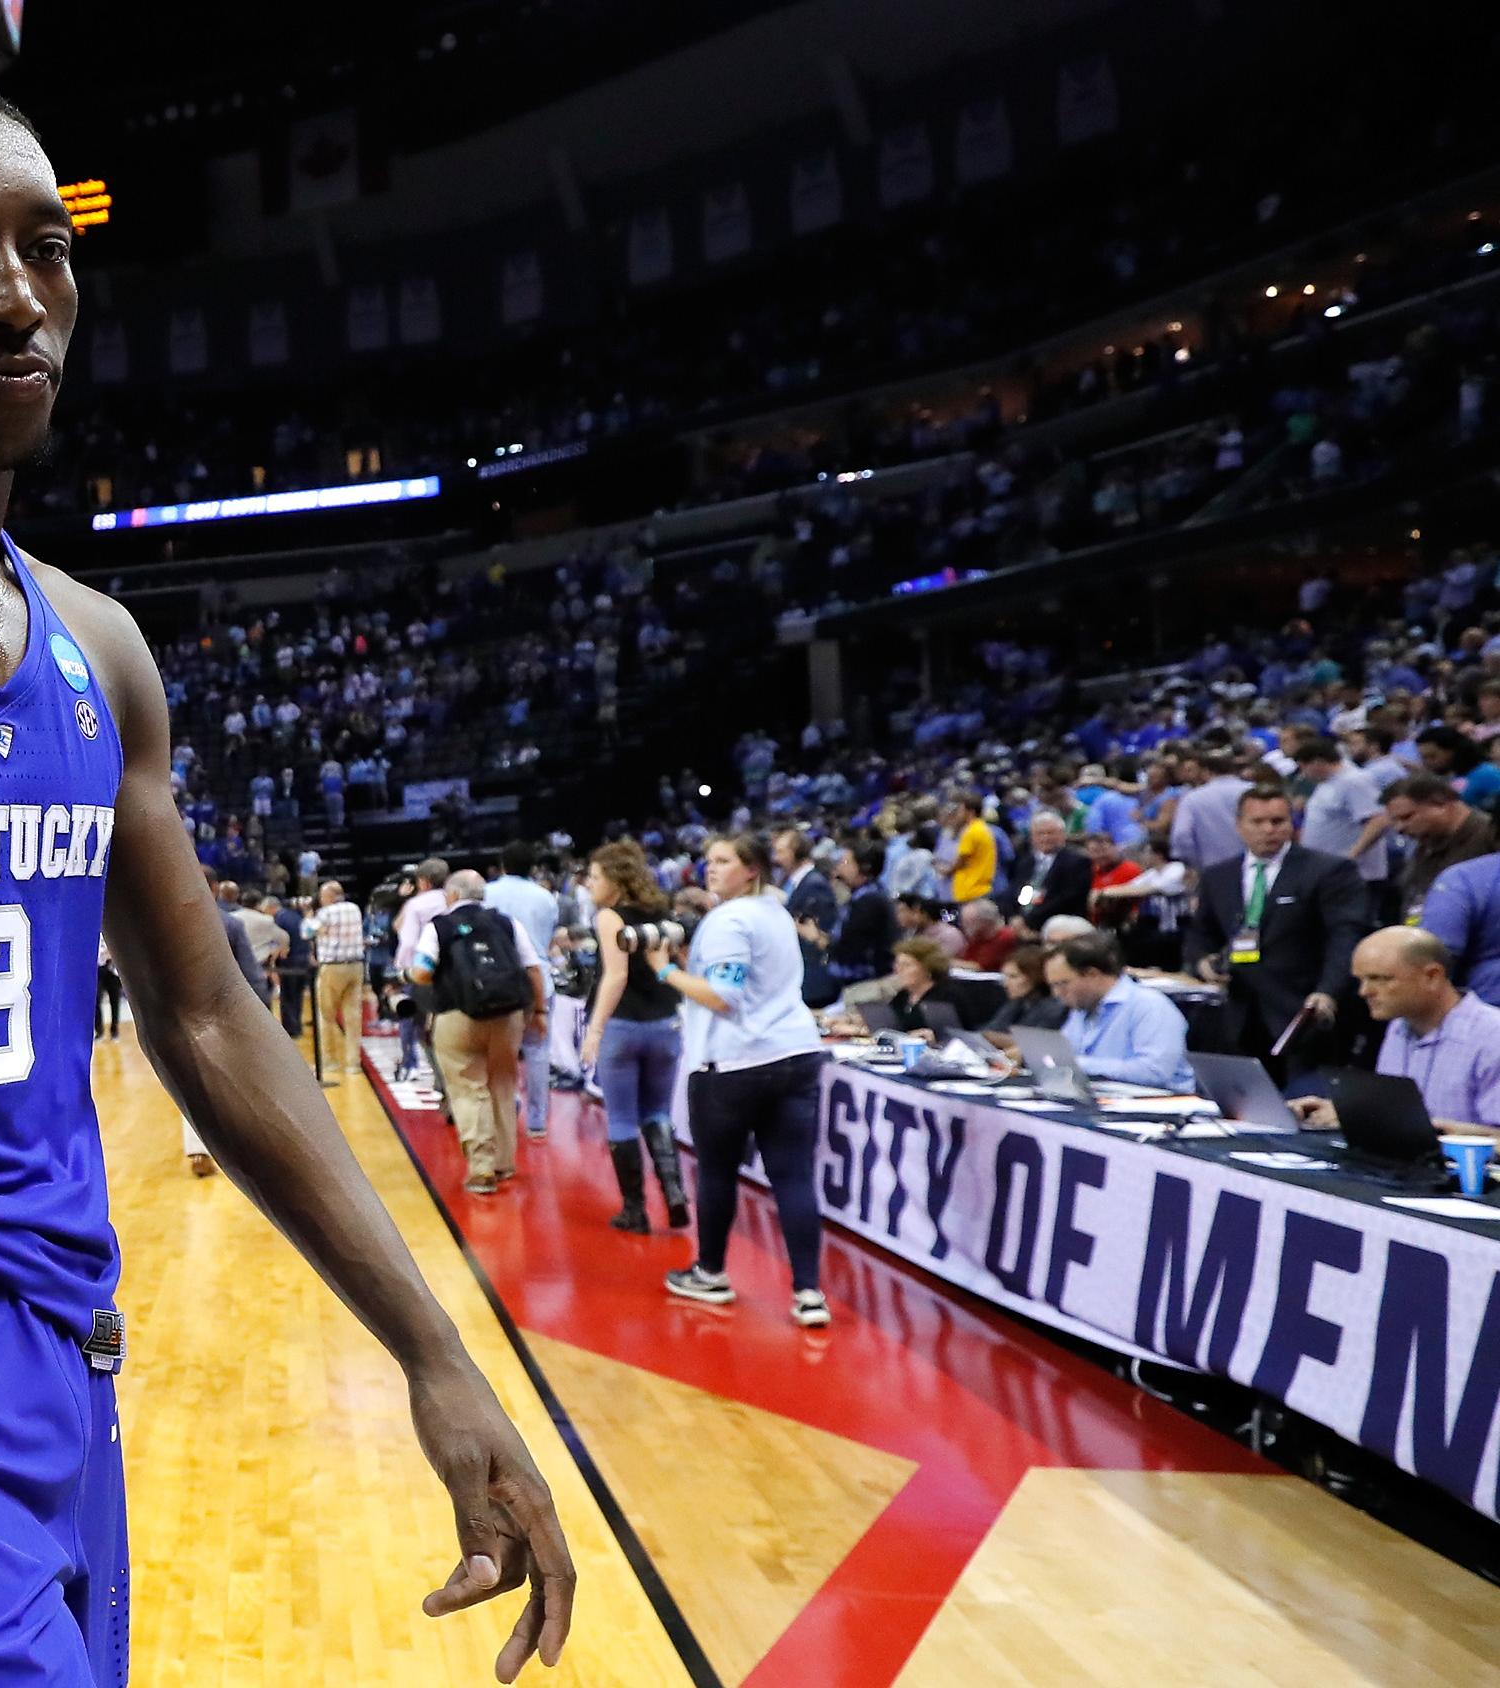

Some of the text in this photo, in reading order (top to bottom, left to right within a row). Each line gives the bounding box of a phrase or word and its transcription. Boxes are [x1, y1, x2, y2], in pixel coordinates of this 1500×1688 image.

[59, 658, 90, 681] NCAA
[77, 702, 98, 738] SEC
[986, 1133, 1107, 1309] OF
